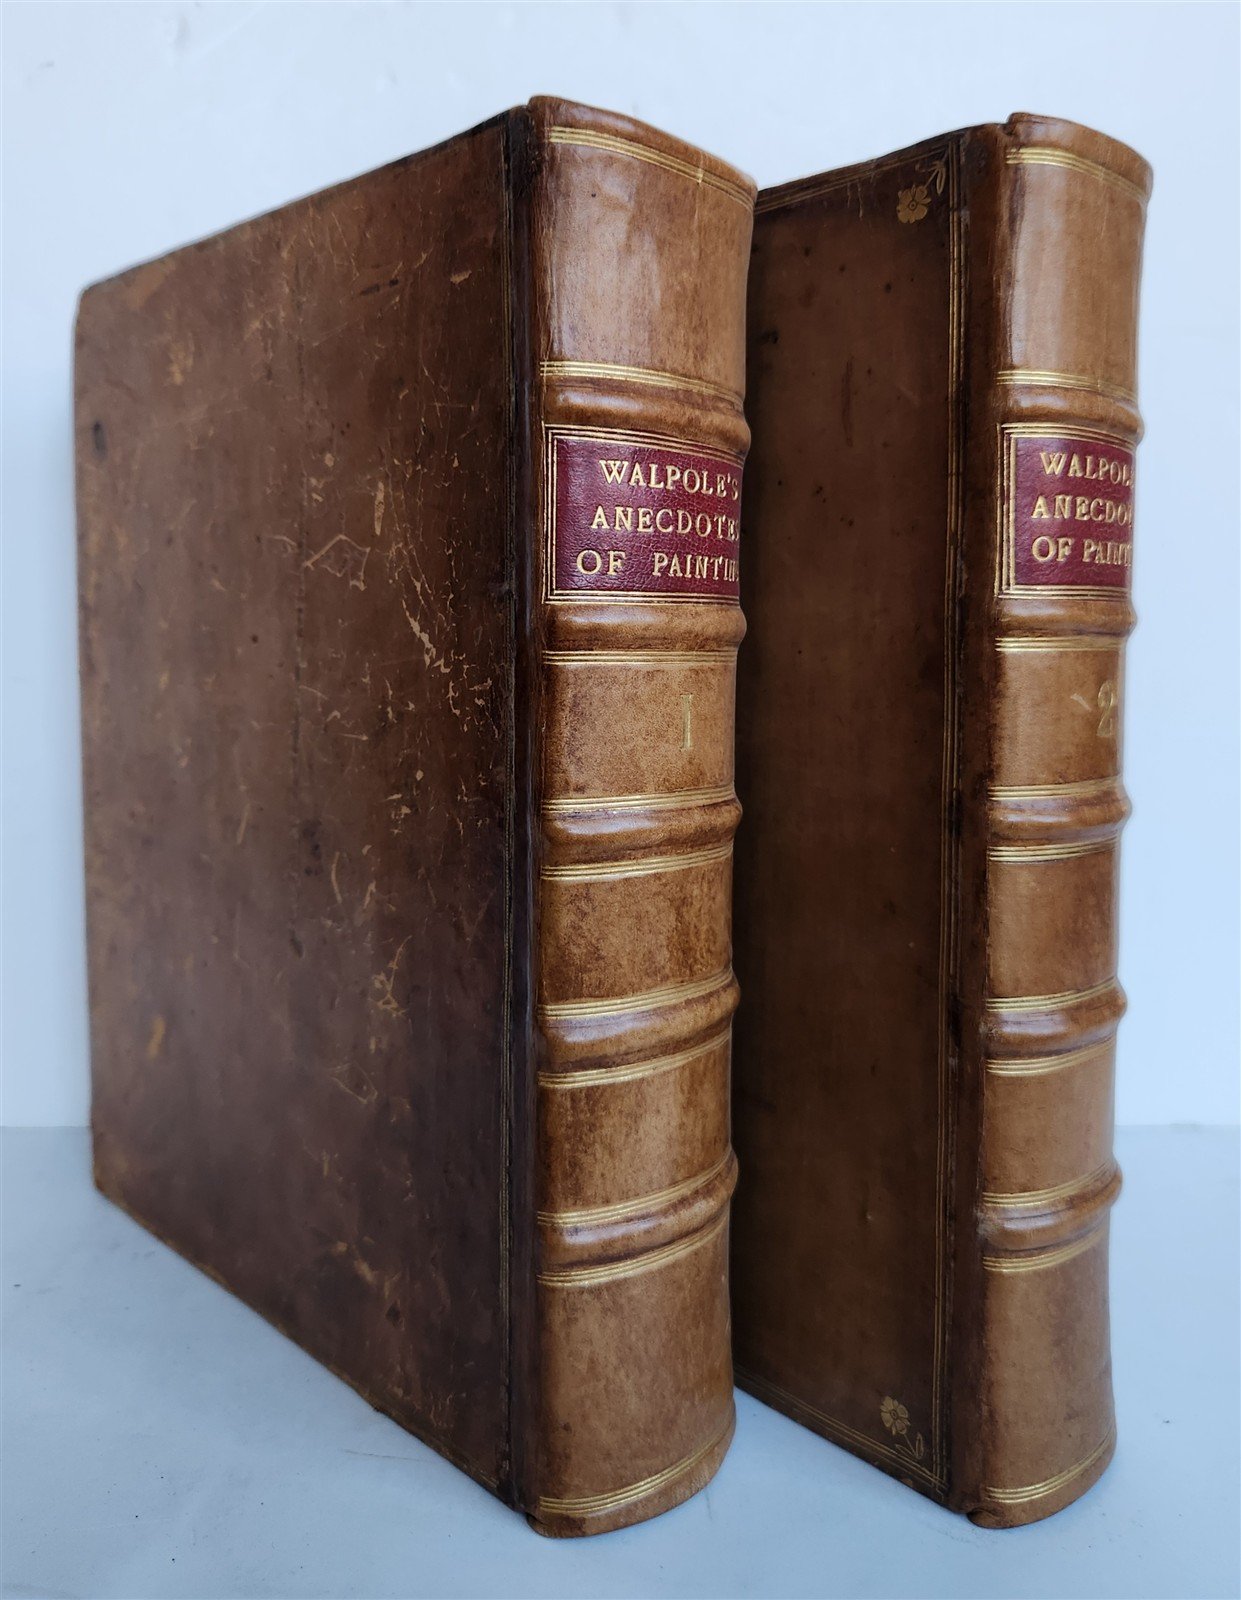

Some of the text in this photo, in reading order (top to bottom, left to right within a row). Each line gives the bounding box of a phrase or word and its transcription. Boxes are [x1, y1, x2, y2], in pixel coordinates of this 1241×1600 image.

[599, 460, 739, 500] WALPOLE'S
[1039, 452, 1133, 488] WALPOL
[577, 549, 626, 576] OF
[1032, 535, 1074, 563] OF
